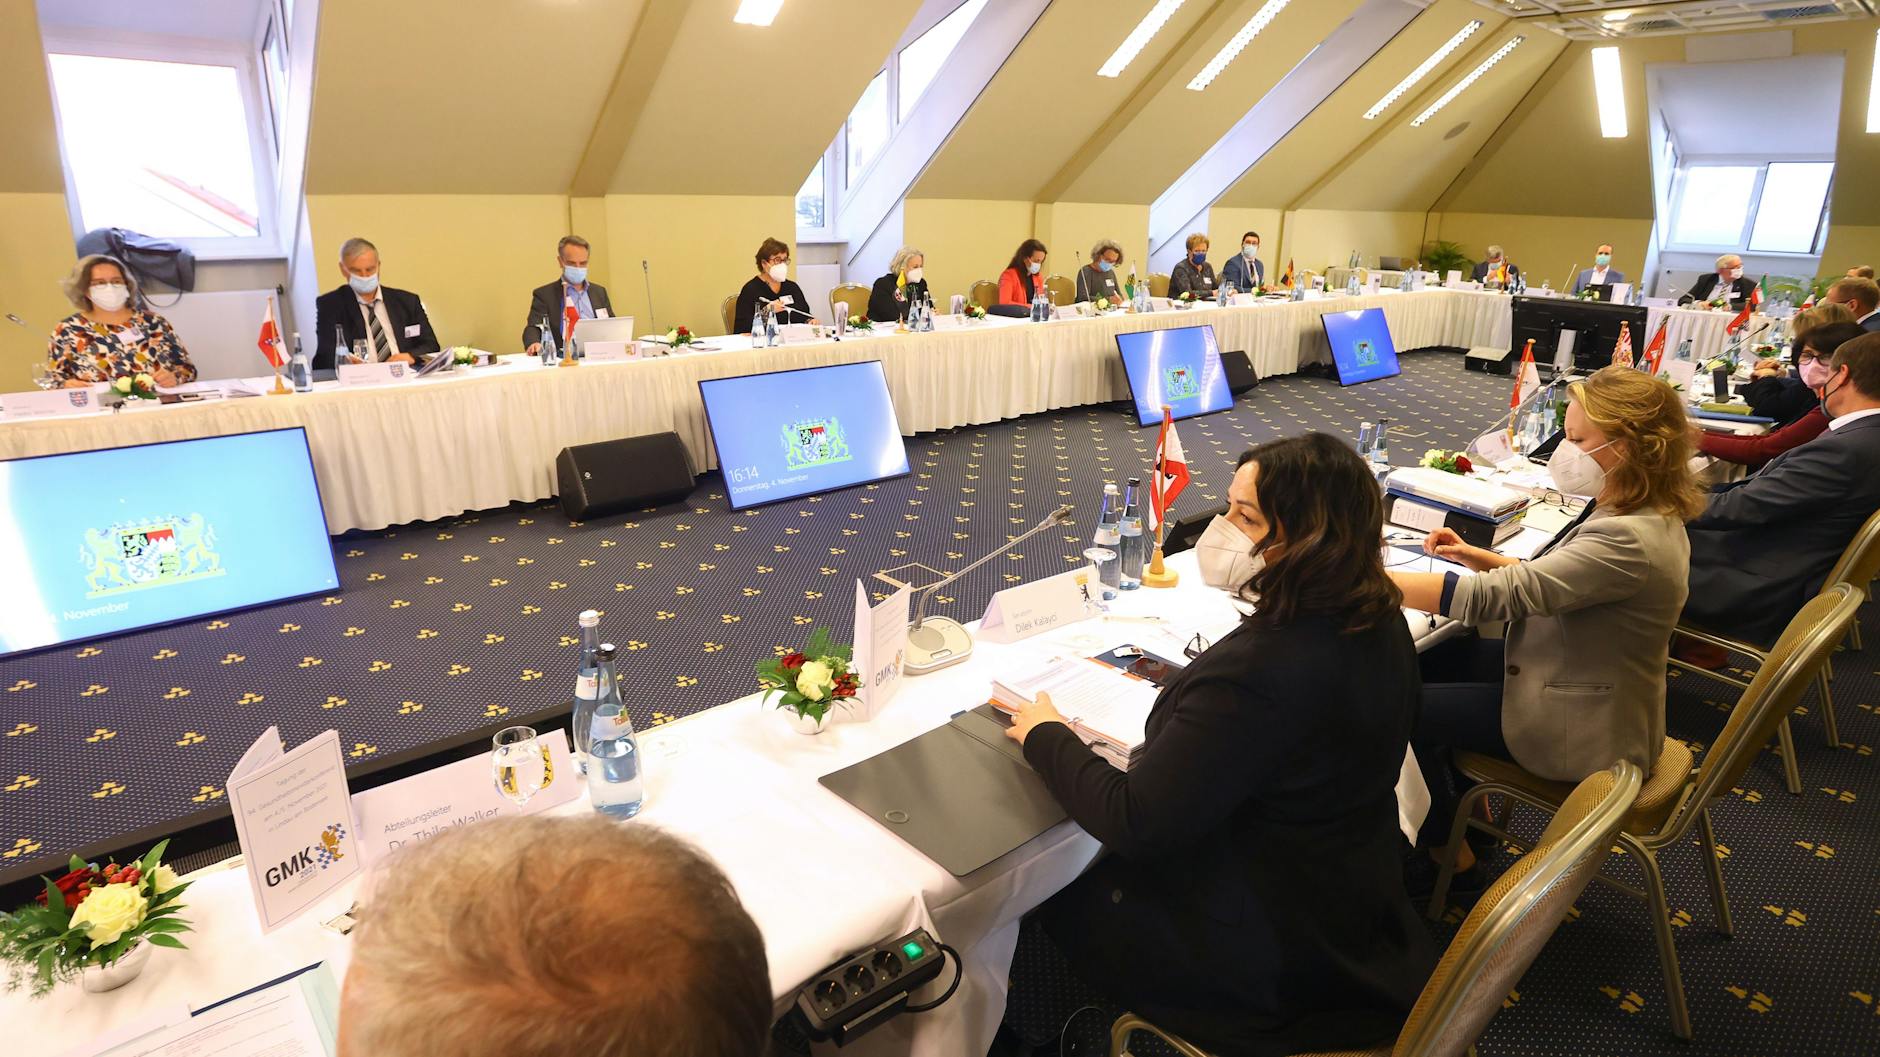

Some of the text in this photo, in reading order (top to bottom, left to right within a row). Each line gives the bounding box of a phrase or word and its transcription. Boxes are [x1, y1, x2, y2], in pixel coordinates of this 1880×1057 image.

[728, 465, 759, 482] 16:14
[64, 602, 129, 621] November
[384, 805, 452, 833] Abteilungsleiter
[452, 807, 499, 828] Walker
[265, 846, 314, 888] GMK
